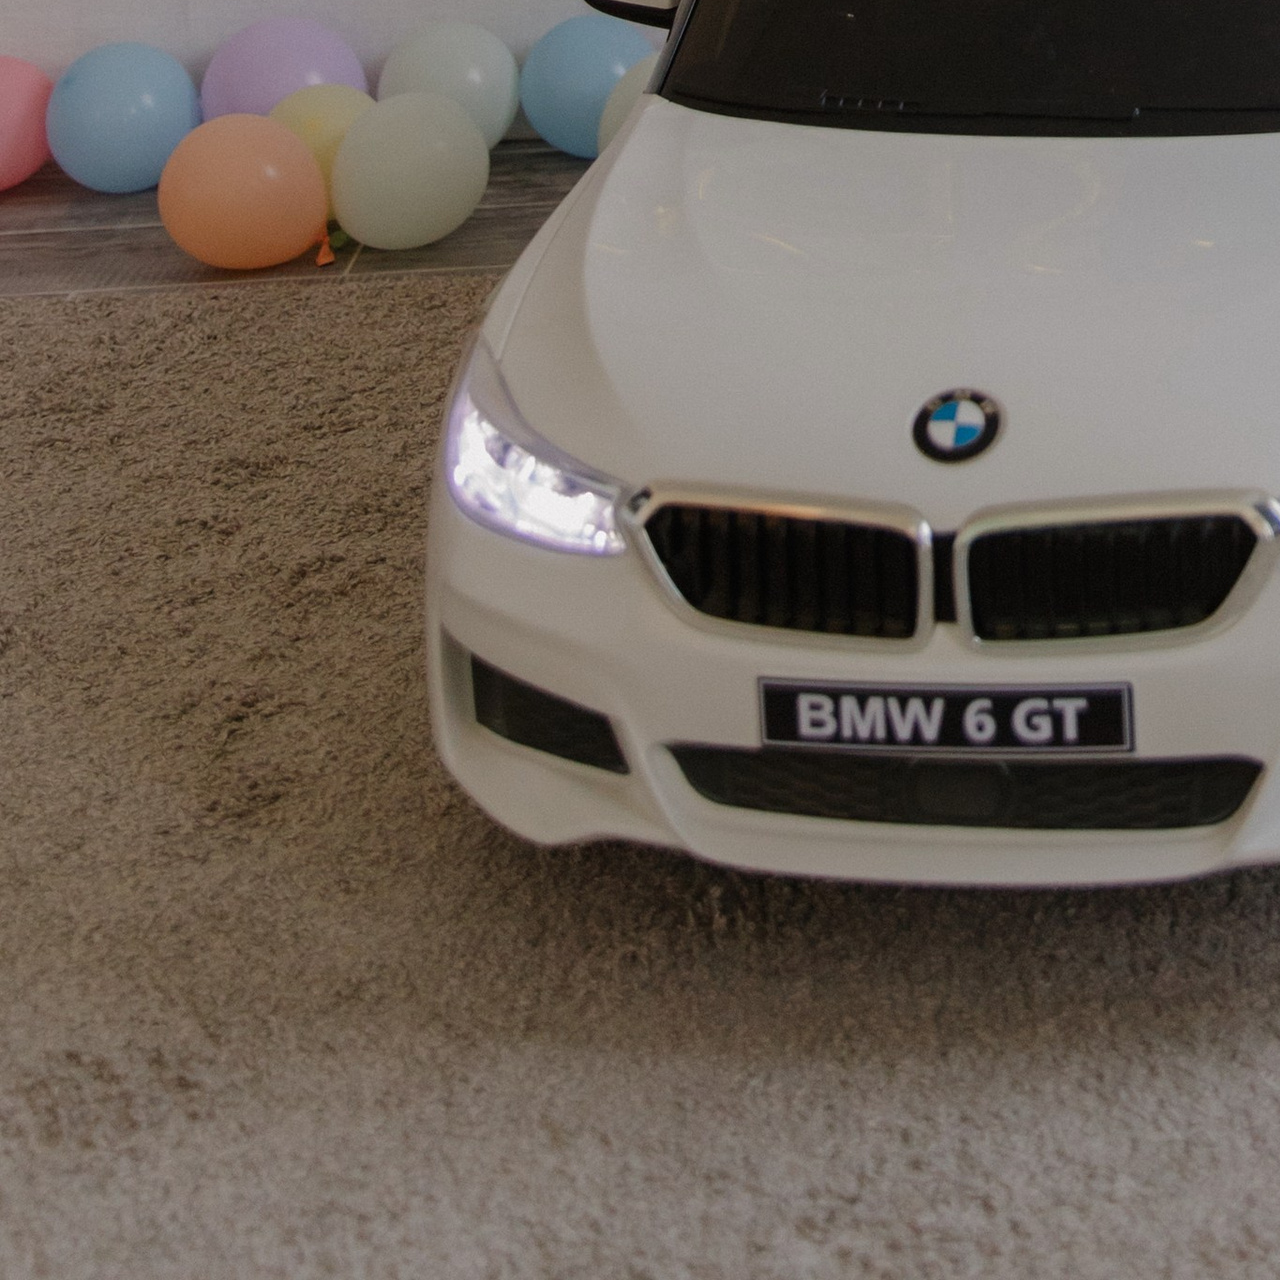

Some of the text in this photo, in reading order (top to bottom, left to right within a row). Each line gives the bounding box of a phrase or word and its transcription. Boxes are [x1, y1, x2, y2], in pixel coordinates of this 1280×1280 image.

[796, 691, 1089, 742] BMW 6 GT
